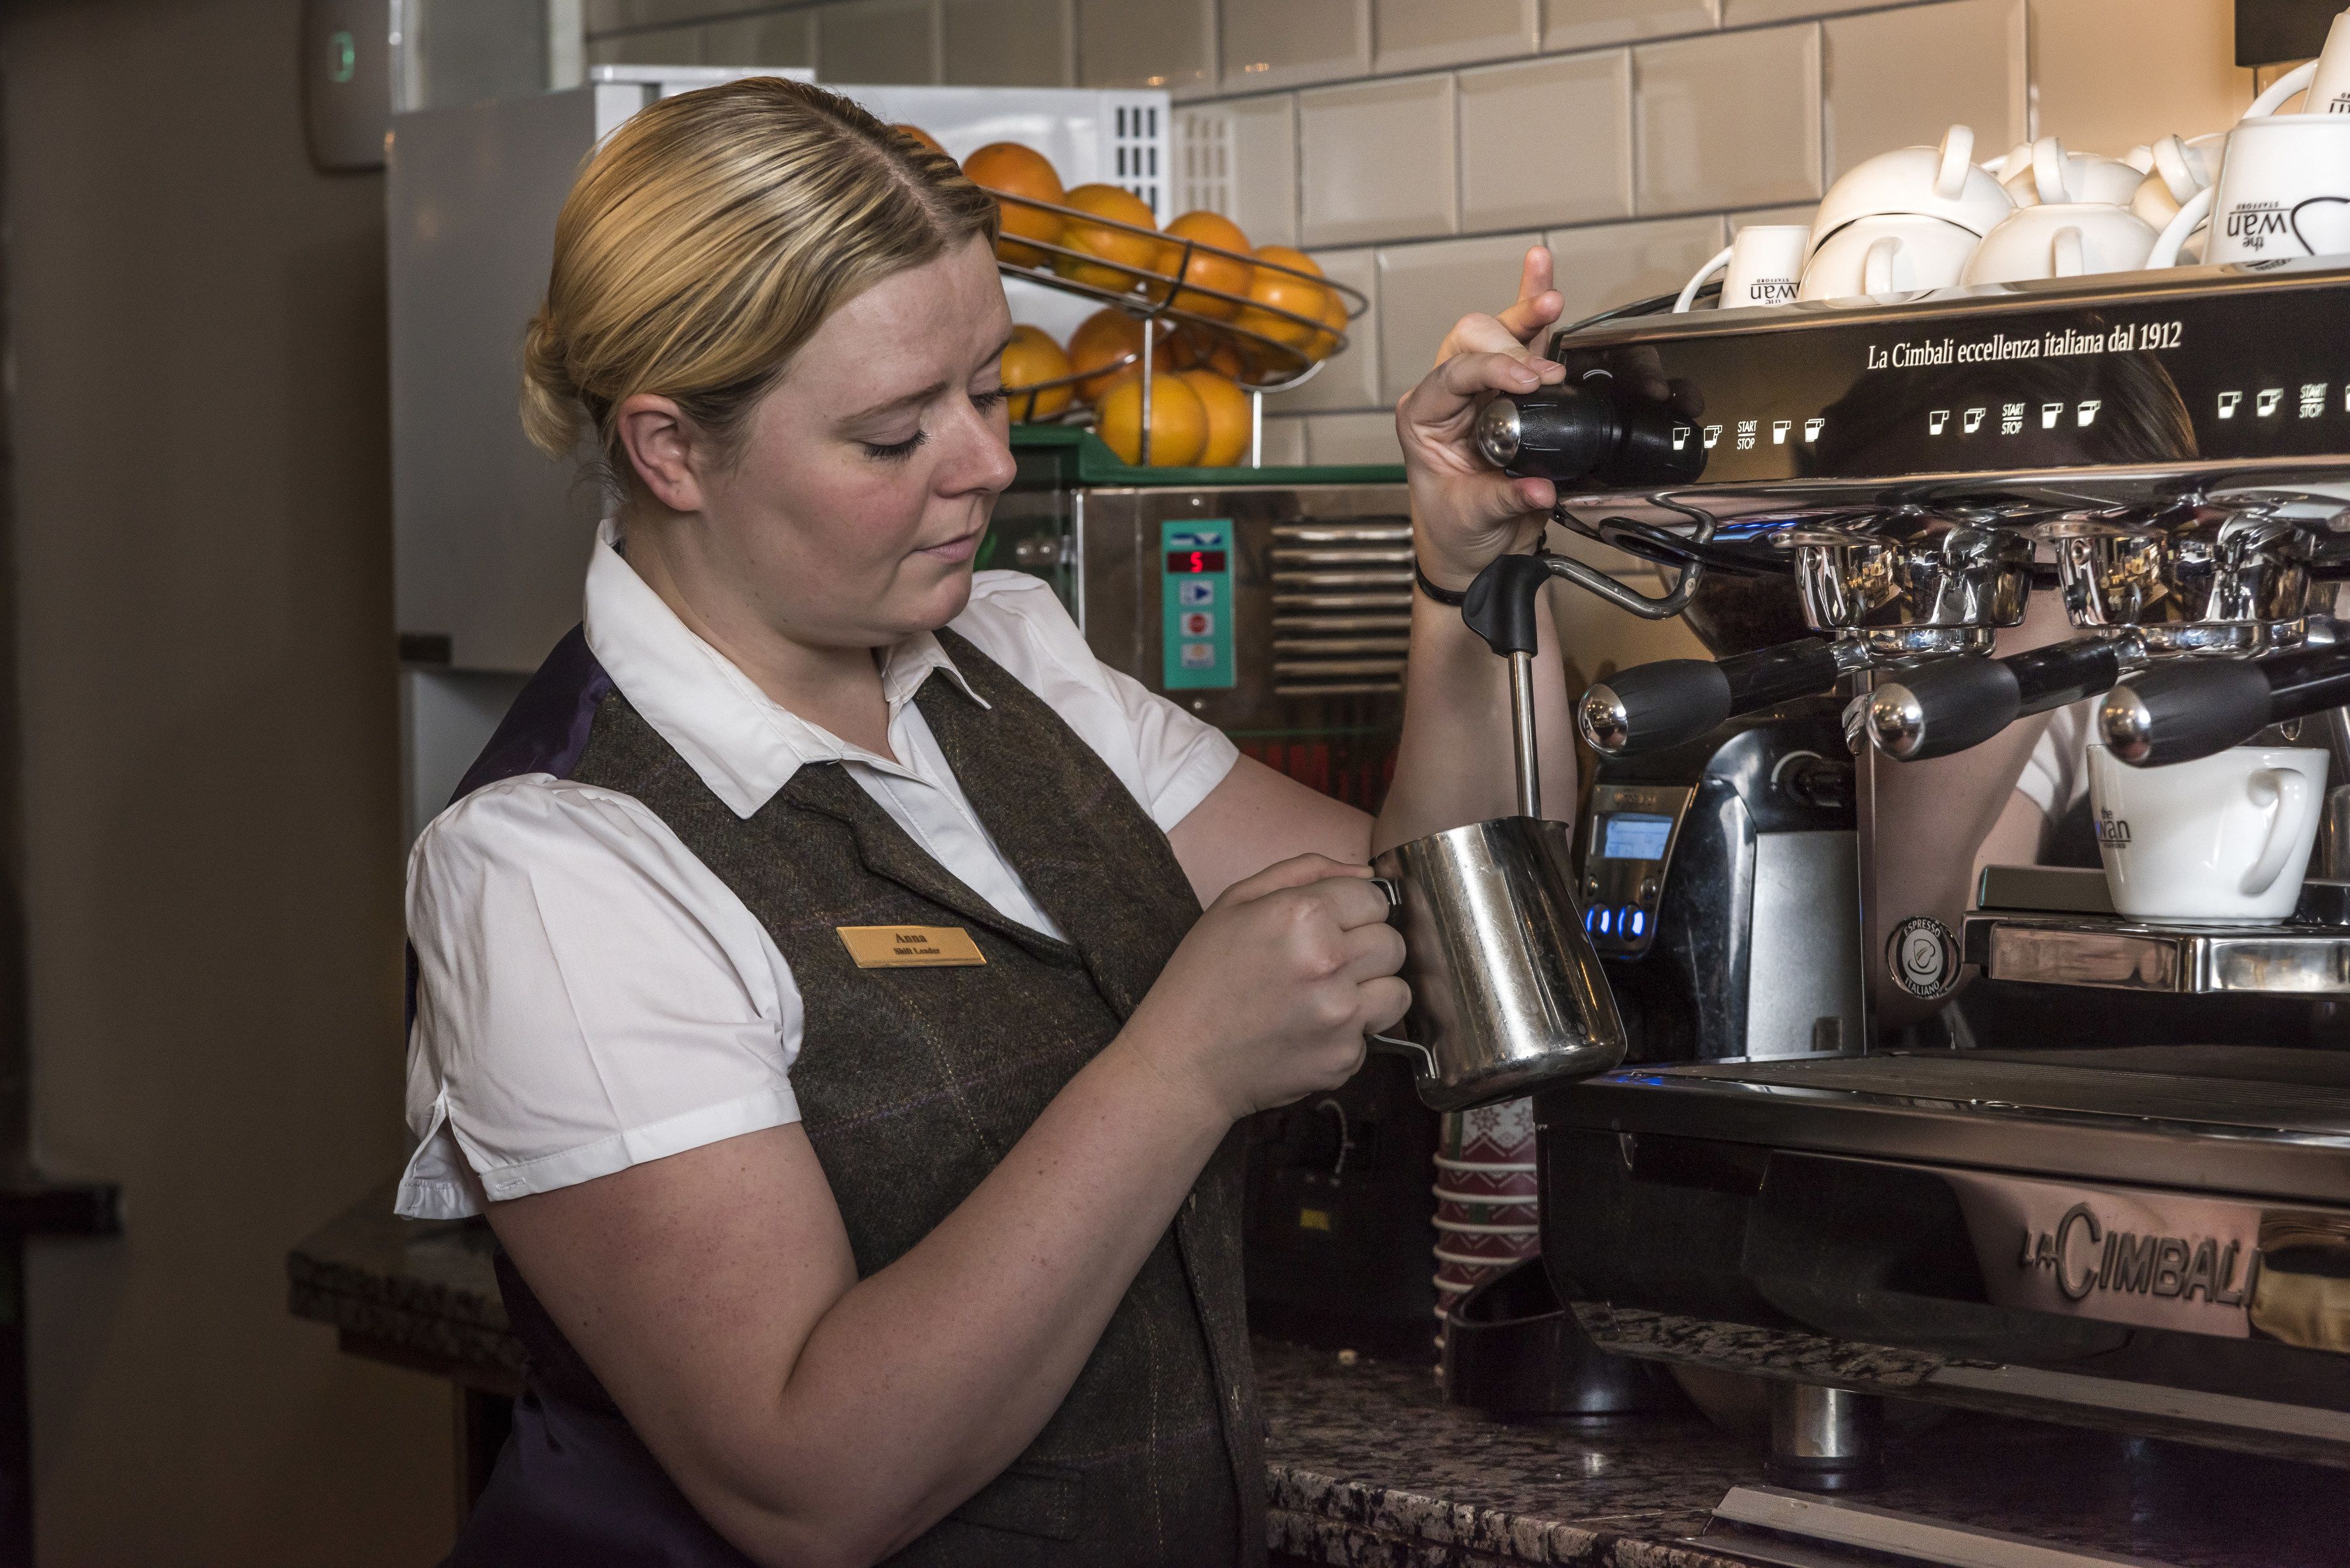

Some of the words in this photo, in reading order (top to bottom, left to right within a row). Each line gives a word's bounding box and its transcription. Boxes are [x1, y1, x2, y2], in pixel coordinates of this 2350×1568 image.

[2242, 236, 2264, 252] the
[1867, 345, 1888, 370] La
[1892, 338, 1954, 368] Cimbali
[1957, 334, 2040, 363] eccellenza
[2043, 328, 2104, 357] italiana
[2107, 324, 2135, 352] dal
[2139, 321, 2183, 350] 1912
[2300, 383, 2328, 399] START
[2002, 402, 2026, 416] START
[2299, 403, 2325, 418] STOP
[1737, 420, 1757, 433] START
[2001, 421, 2023, 435] STOP
[1737, 437, 1755, 449] STOP
[1904, 919, 1941, 937] ESPRESSO
[895, 933, 928, 943] Anna
[1905, 977, 1940, 995] ITALIANO
[2020, 1231, 2058, 1269] LA
[2056, 1202, 2263, 1309] CIMBALI
